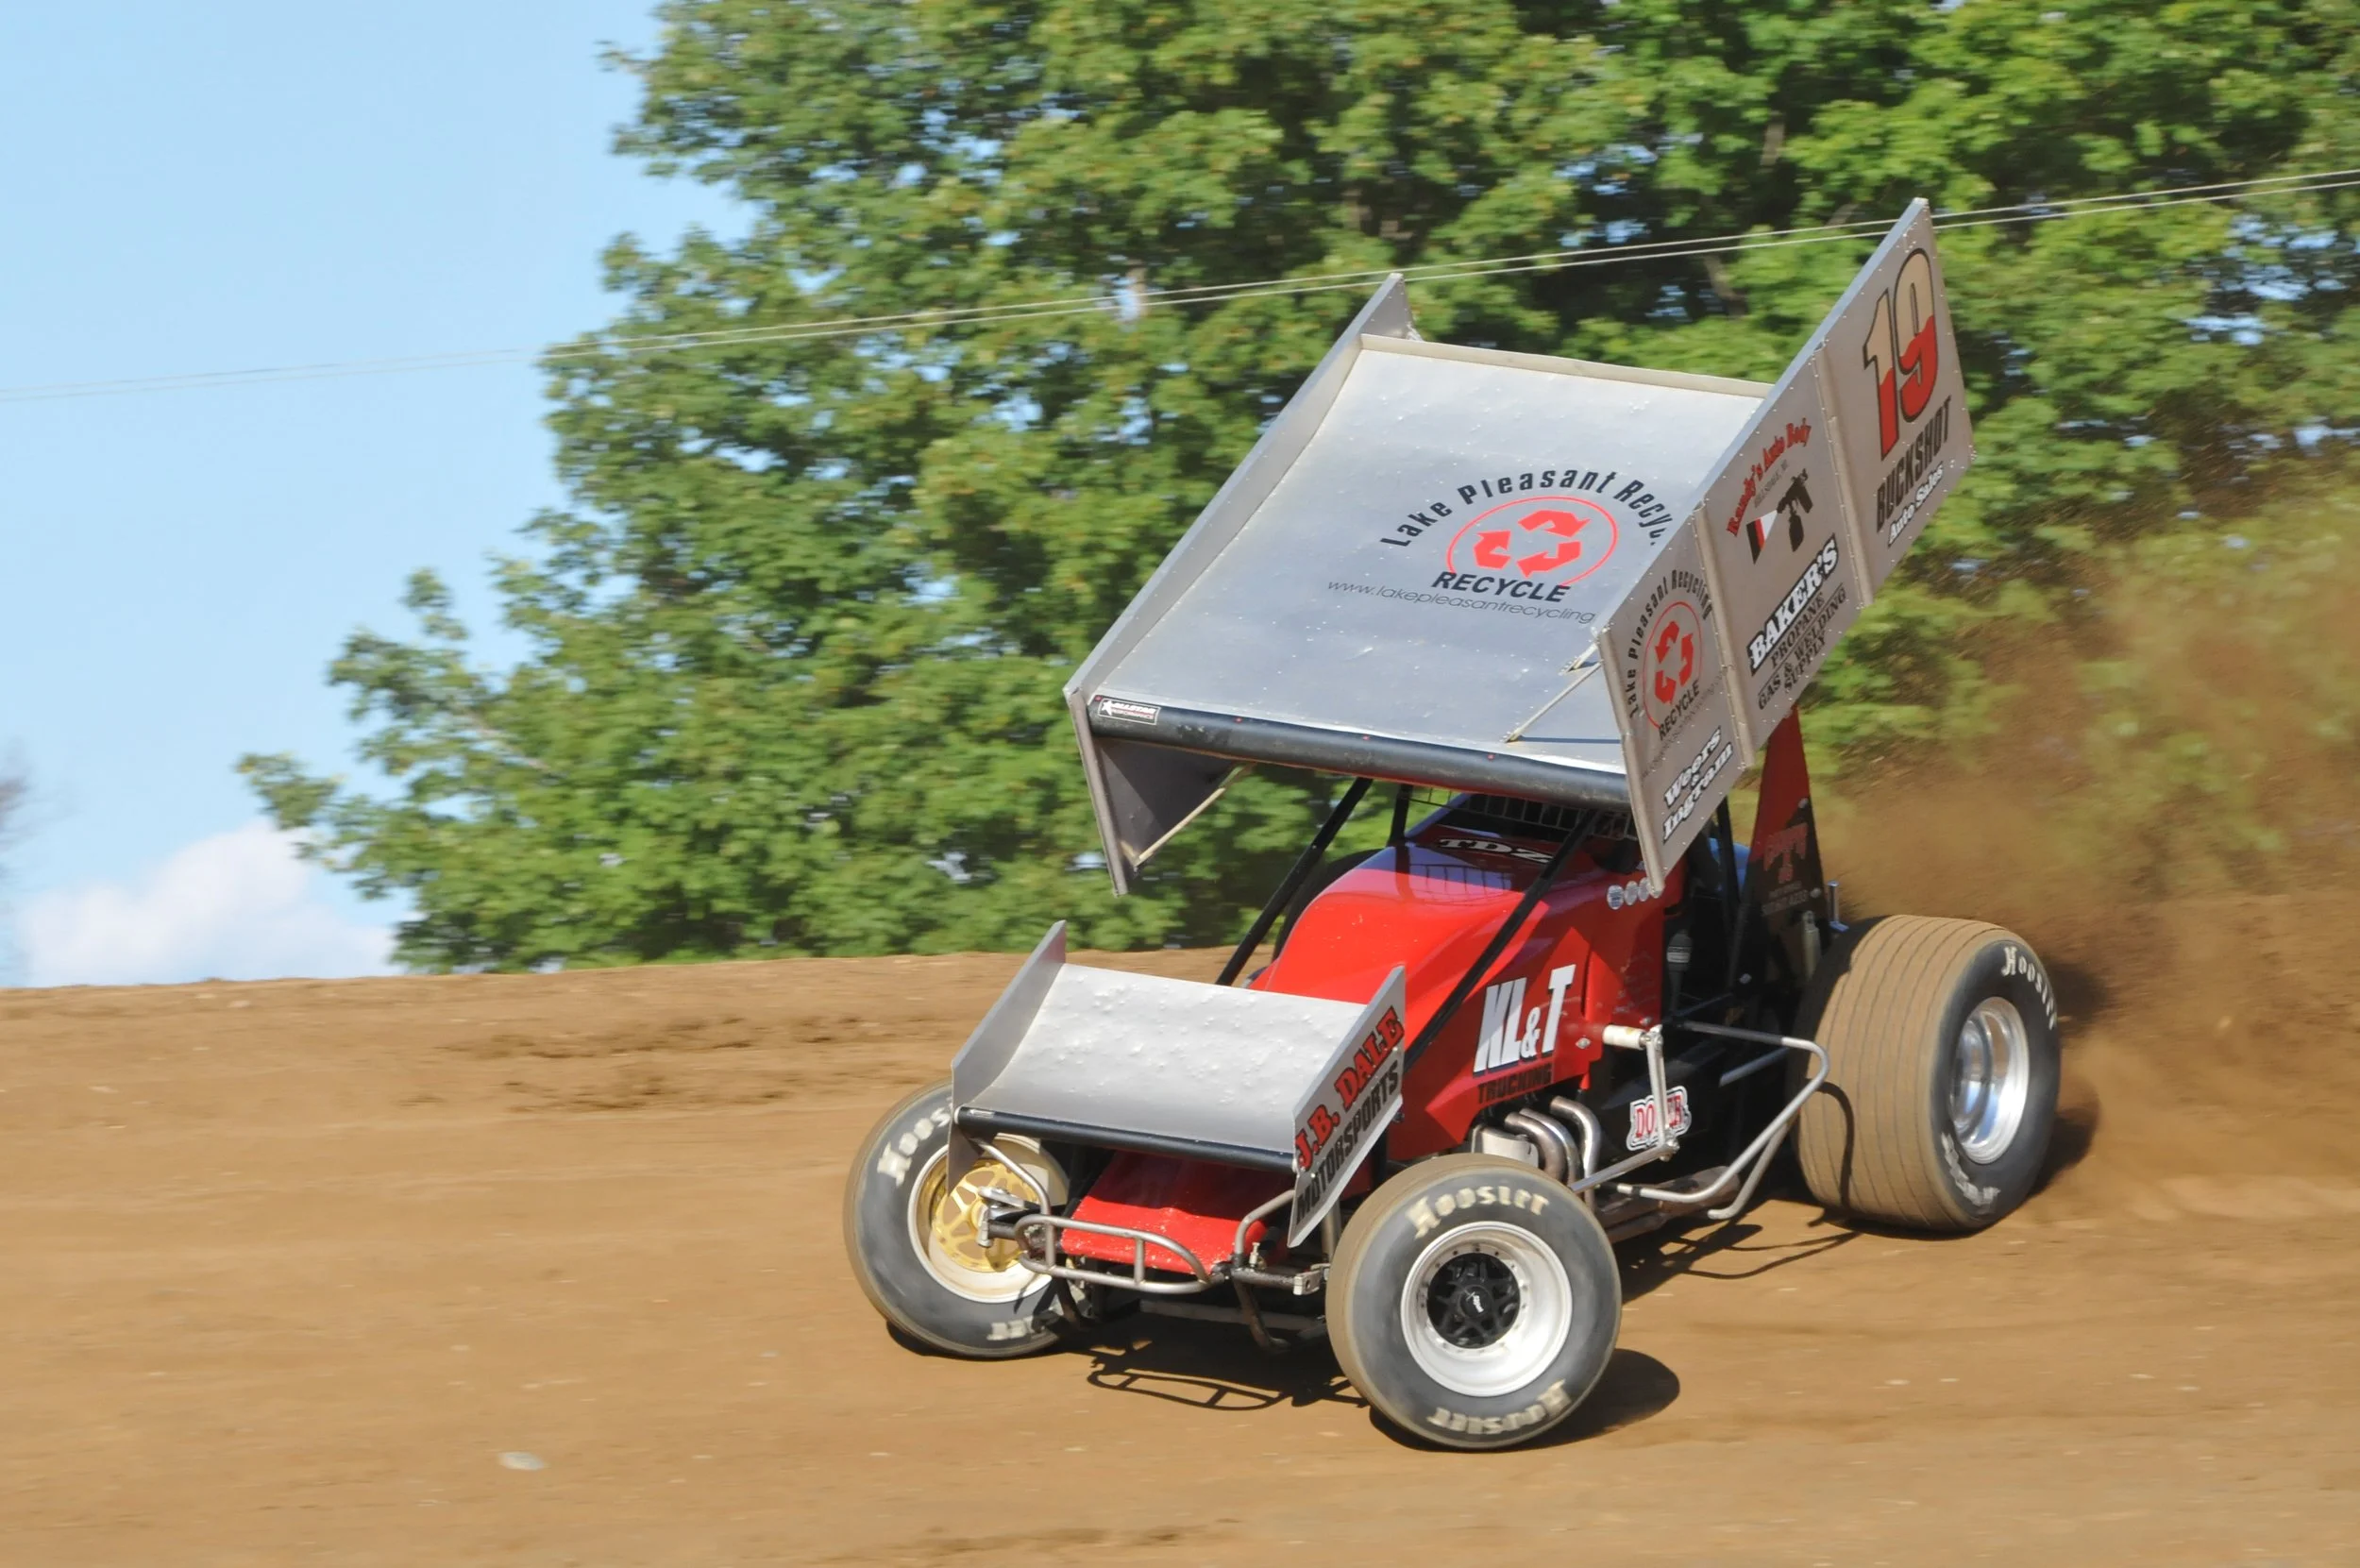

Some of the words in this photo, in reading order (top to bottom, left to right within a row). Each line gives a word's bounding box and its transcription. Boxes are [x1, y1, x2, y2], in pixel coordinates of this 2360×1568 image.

[1863, 247, 1939, 463] 19
[1876, 395, 1952, 533] BUCKSHOT
[1380, 501, 1453, 548] Lake
[1457, 469, 1618, 505] Pleasant
[1887, 502, 1916, 548] Auto
[1431, 570, 1573, 603] RECYCLE
[1627, 576, 1669, 660] Pleasant
[1747, 534, 1838, 675] BAKER'S
[1759, 675, 1781, 710] GAS
[1794, 587, 1847, 661] WELDING
[1770, 591, 1826, 669] PROPANE
[1783, 627, 1828, 694] SUPPLY
[1658, 679, 1701, 741] RECYCLE
[1437, 837, 1557, 864] TDZ
[1294, 1104, 1341, 1172] J.B.
[1333, 1005, 1406, 1112] DALE
[1295, 1059, 1399, 1226] MOTORSPORTS
